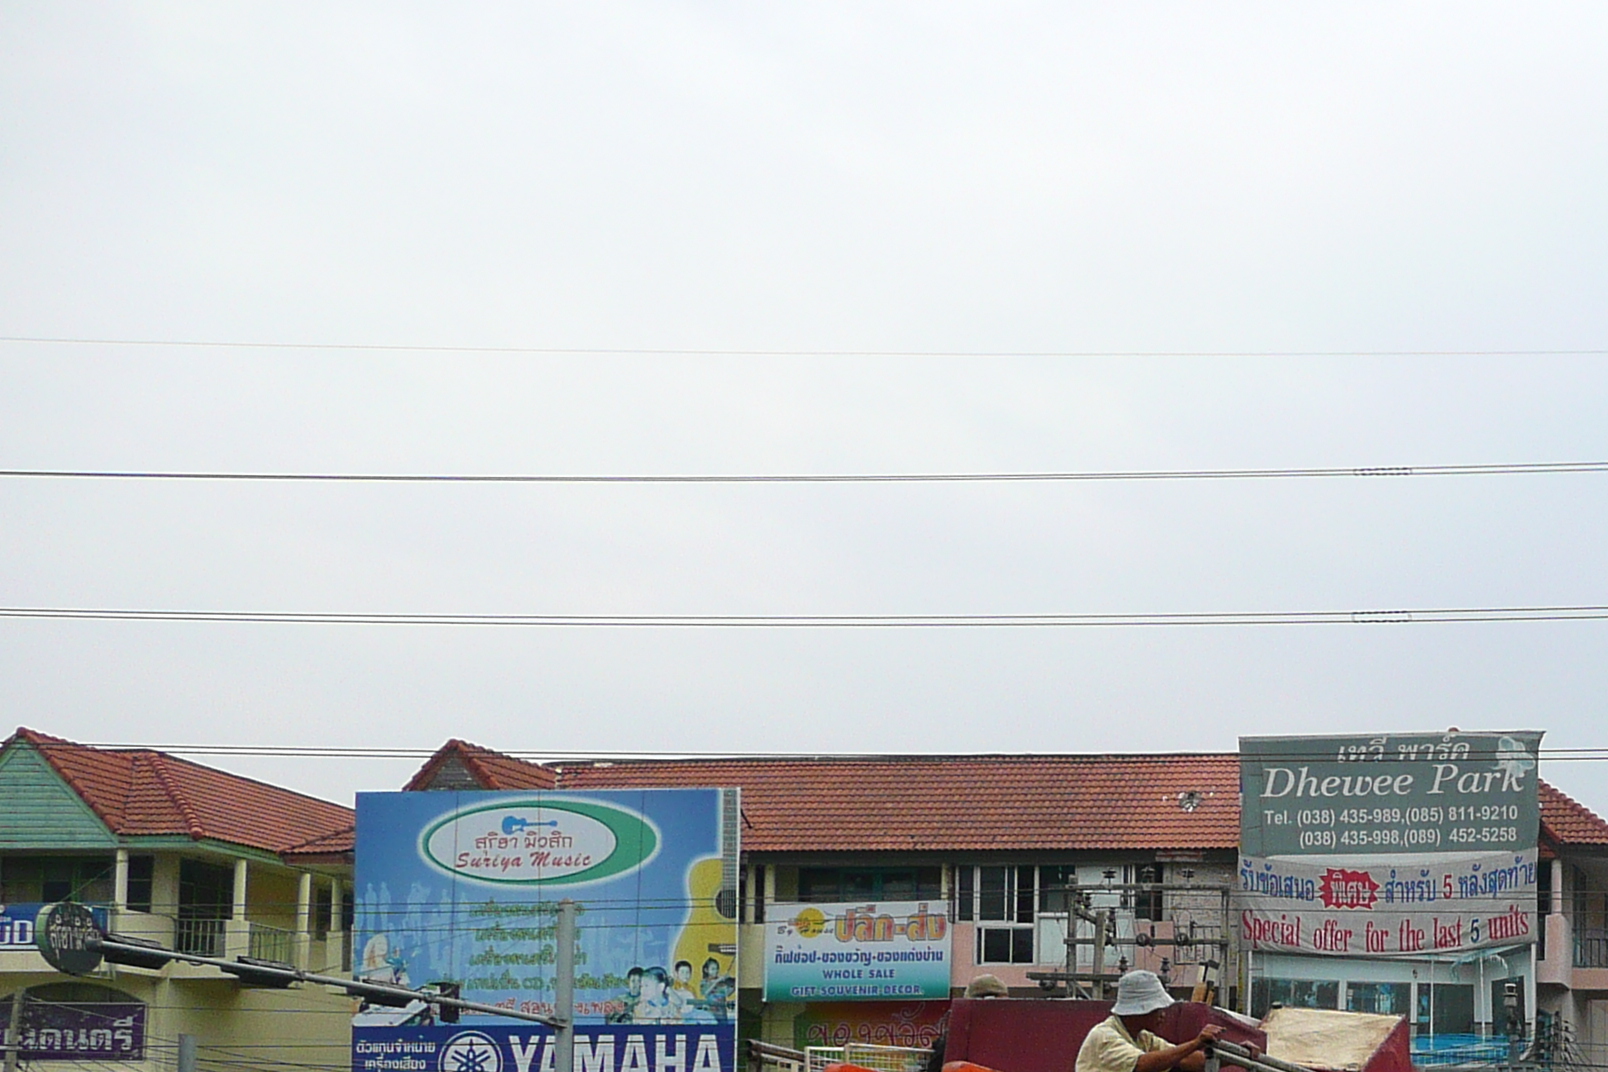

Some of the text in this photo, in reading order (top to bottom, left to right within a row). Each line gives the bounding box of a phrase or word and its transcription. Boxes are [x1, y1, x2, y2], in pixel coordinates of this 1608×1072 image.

[1260, 763, 1524, 798] Dhewee Park
[1265, 810, 1292, 825] Tel.
[1297, 808, 1336, 828] (038)
[1448, 805, 1518, 821] 811-9210
[1299, 829, 1337, 849] (038)
[1448, 827, 1518, 843] 452-5258
[455, 851, 592, 872] Suriya Music
[1443, 874, 1453, 899] 5
[1241, 905, 1529, 952] Special offer for the last 5 units
[822, 969, 896, 980] WHOLE SALE
[791, 986, 817, 996] GIFT
[821, 985, 879, 996] SOUVENIR
